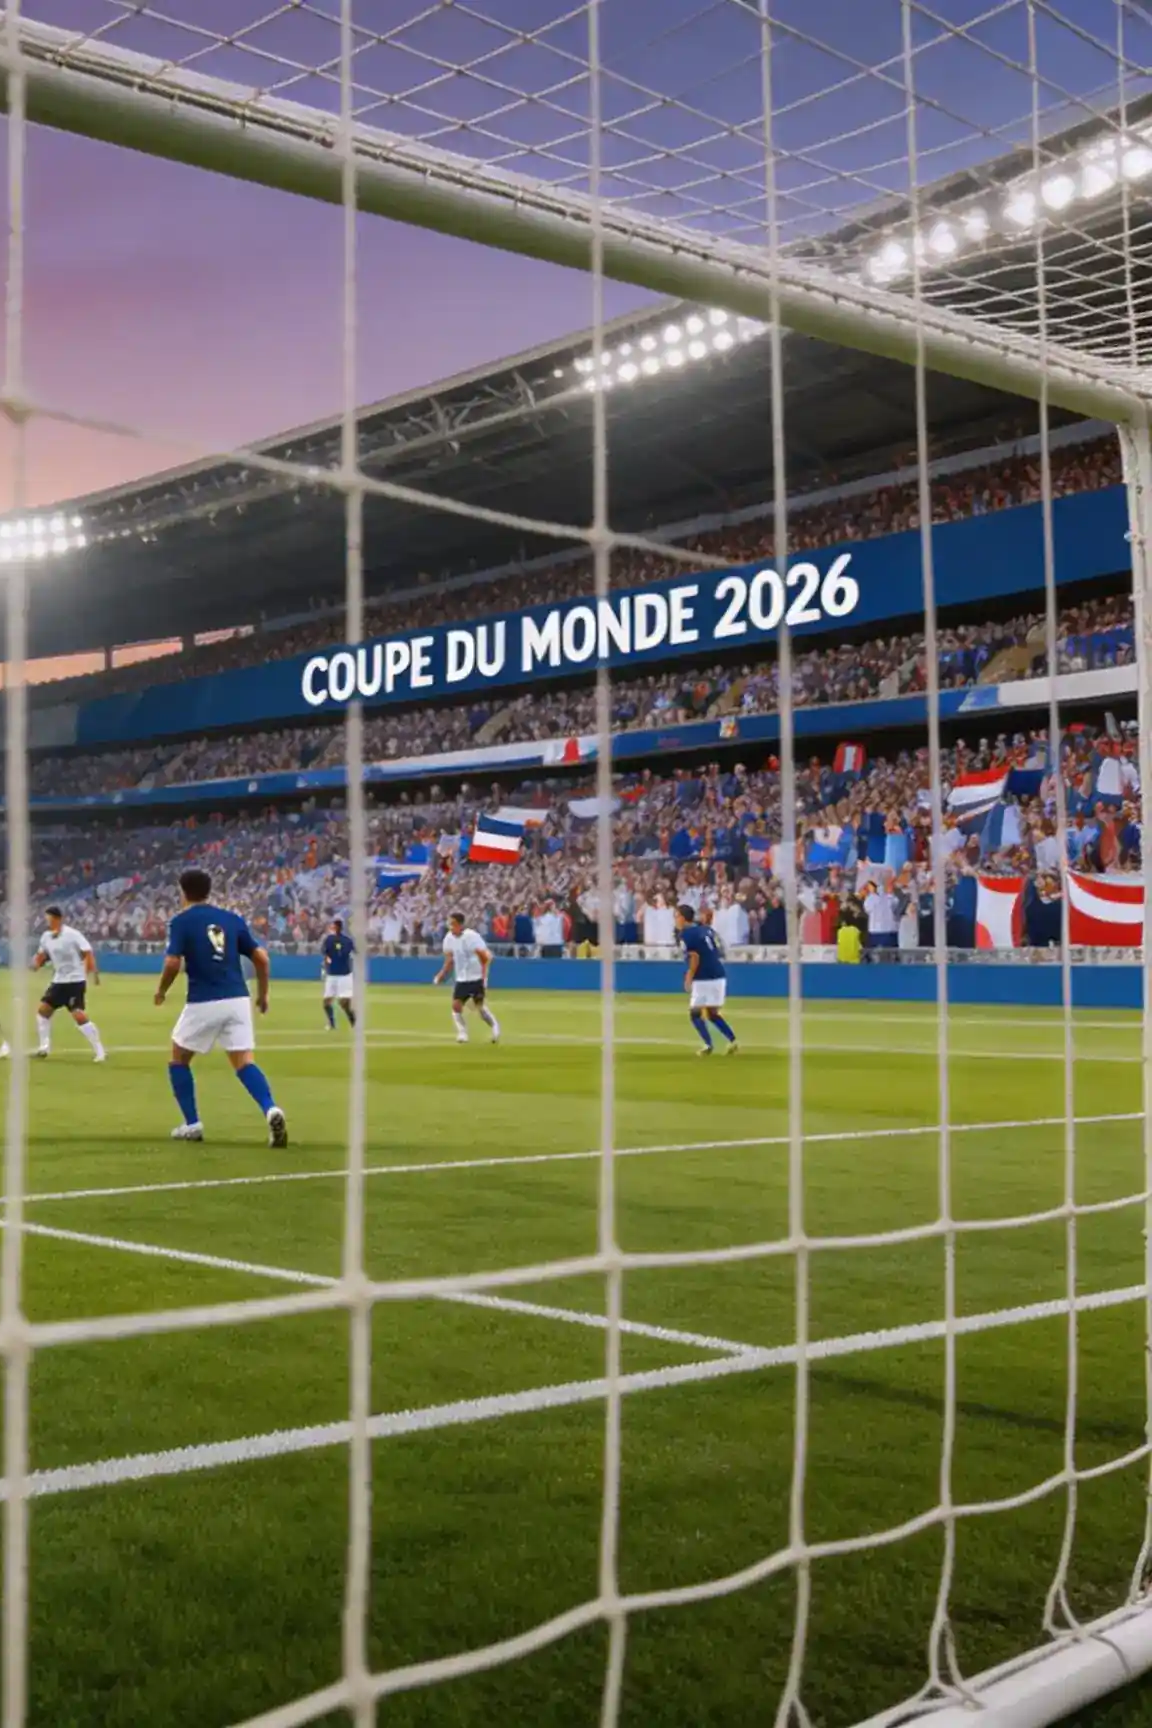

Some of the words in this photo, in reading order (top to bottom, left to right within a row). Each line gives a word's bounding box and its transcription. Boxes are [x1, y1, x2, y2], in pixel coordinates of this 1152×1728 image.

[301, 636, 434, 706] COUPE
[446, 620, 506, 683] DU
[521, 585, 699, 673] MONDE
[713, 553, 860, 638] 2026
